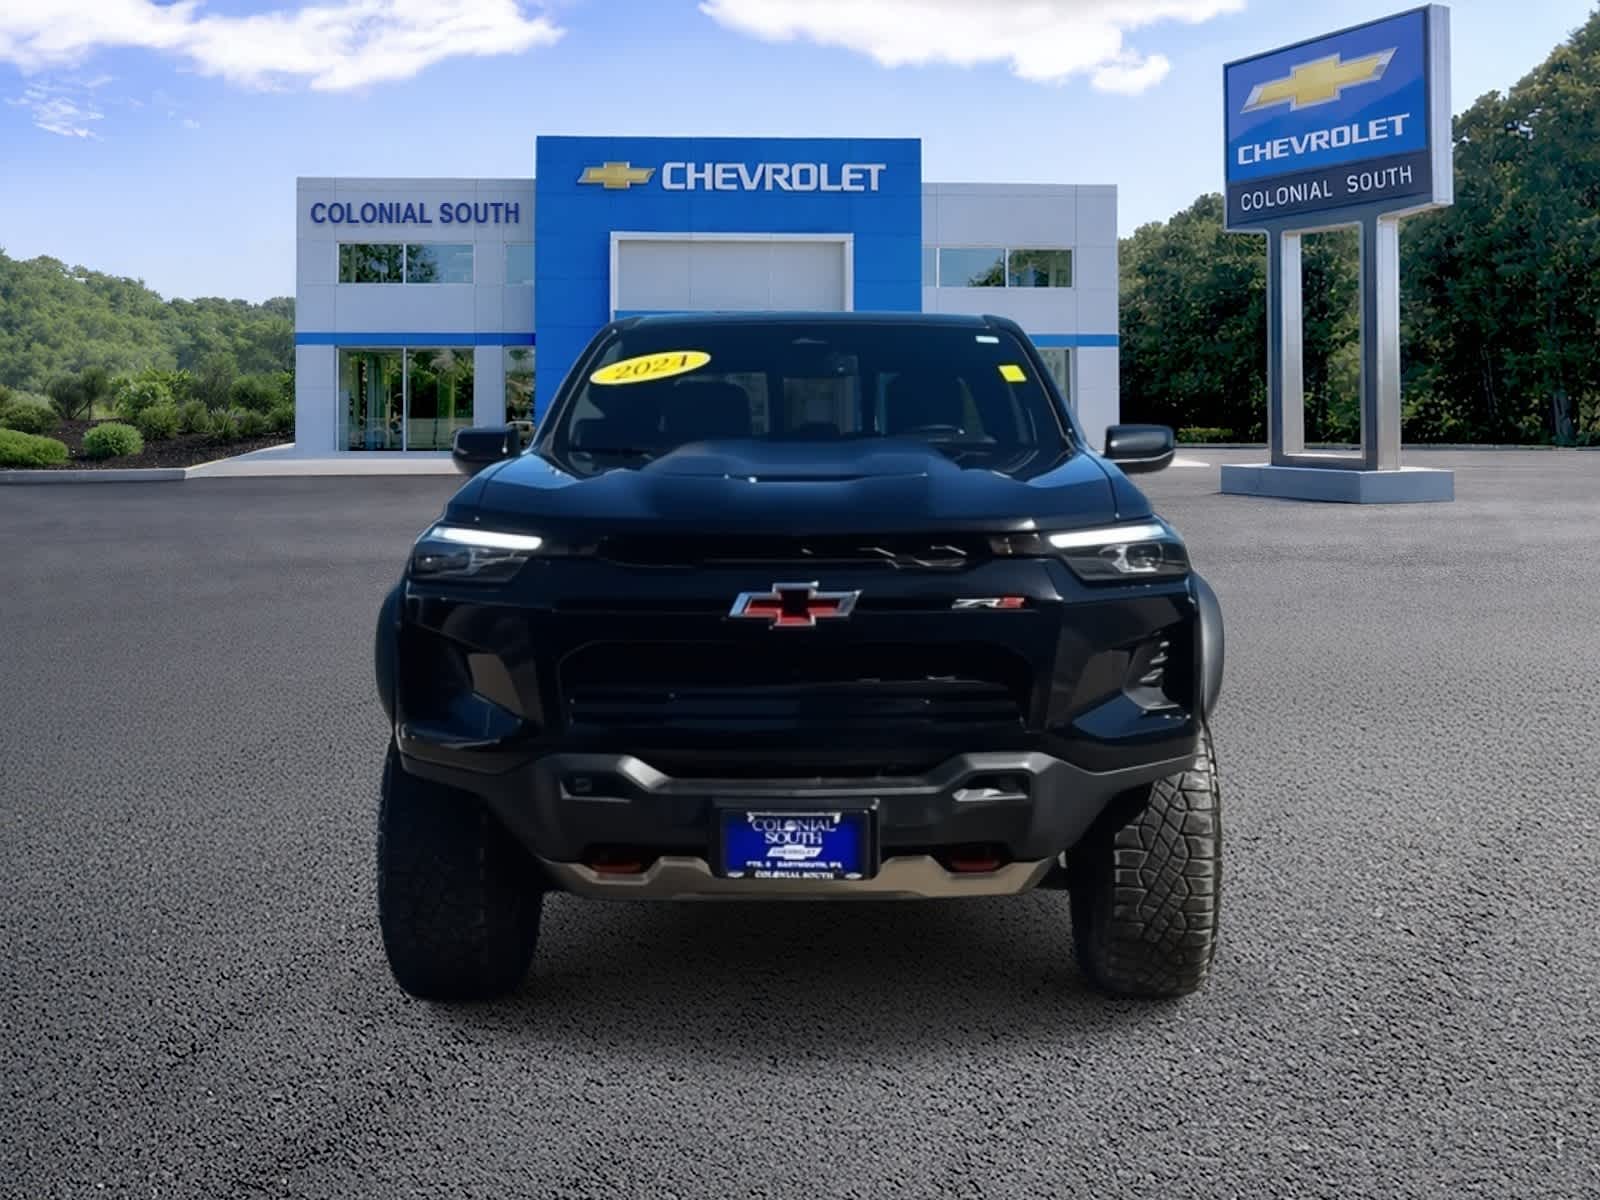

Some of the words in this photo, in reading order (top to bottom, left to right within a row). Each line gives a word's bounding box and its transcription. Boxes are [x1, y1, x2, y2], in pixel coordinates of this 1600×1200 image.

[1237, 113, 1410, 165] CHEVROLET
[662, 162, 887, 191] CHEVROLET
[1241, 180, 1333, 211] COLONIAL
[1347, 165, 1412, 193] SOUTH
[310, 202, 433, 224] COLONIAL
[439, 202, 520, 224] SOUTH
[752, 819, 836, 832] COLONIAL
[765, 832, 823, 844] SOUTH
[755, 870, 800, 878] COLONIAL
